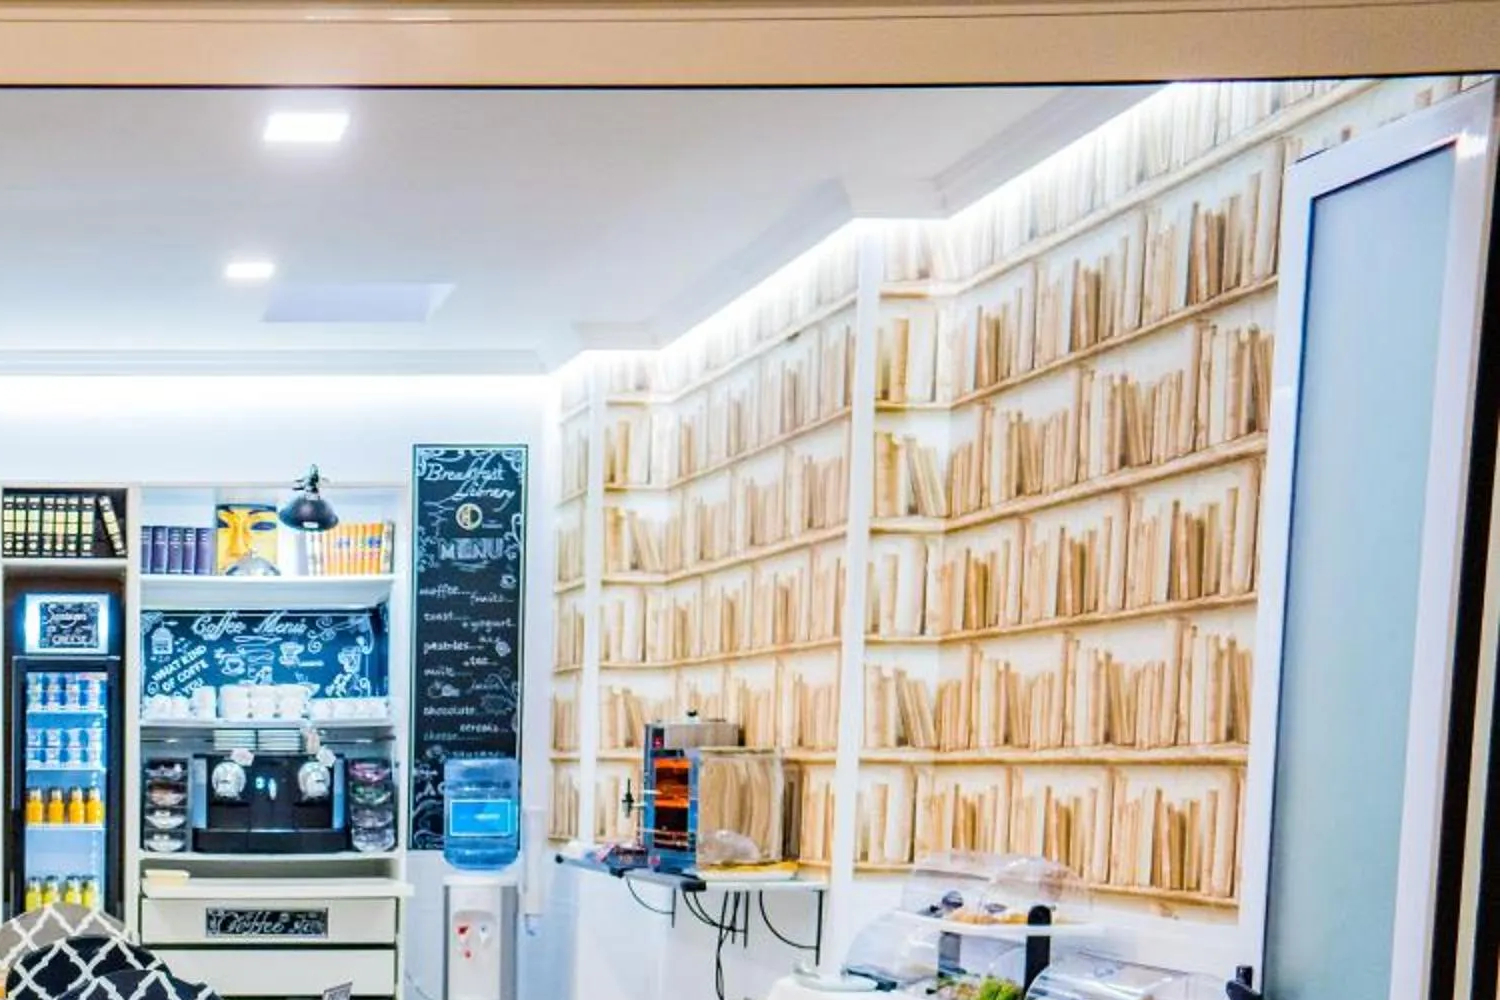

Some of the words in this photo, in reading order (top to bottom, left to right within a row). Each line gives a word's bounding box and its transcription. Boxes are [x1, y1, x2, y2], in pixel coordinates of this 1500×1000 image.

[423, 450, 506, 484] Breakfast
[451, 479, 515, 512] Library
[440, 537, 503, 560] MENU
[192, 612, 247, 641] Coffee
